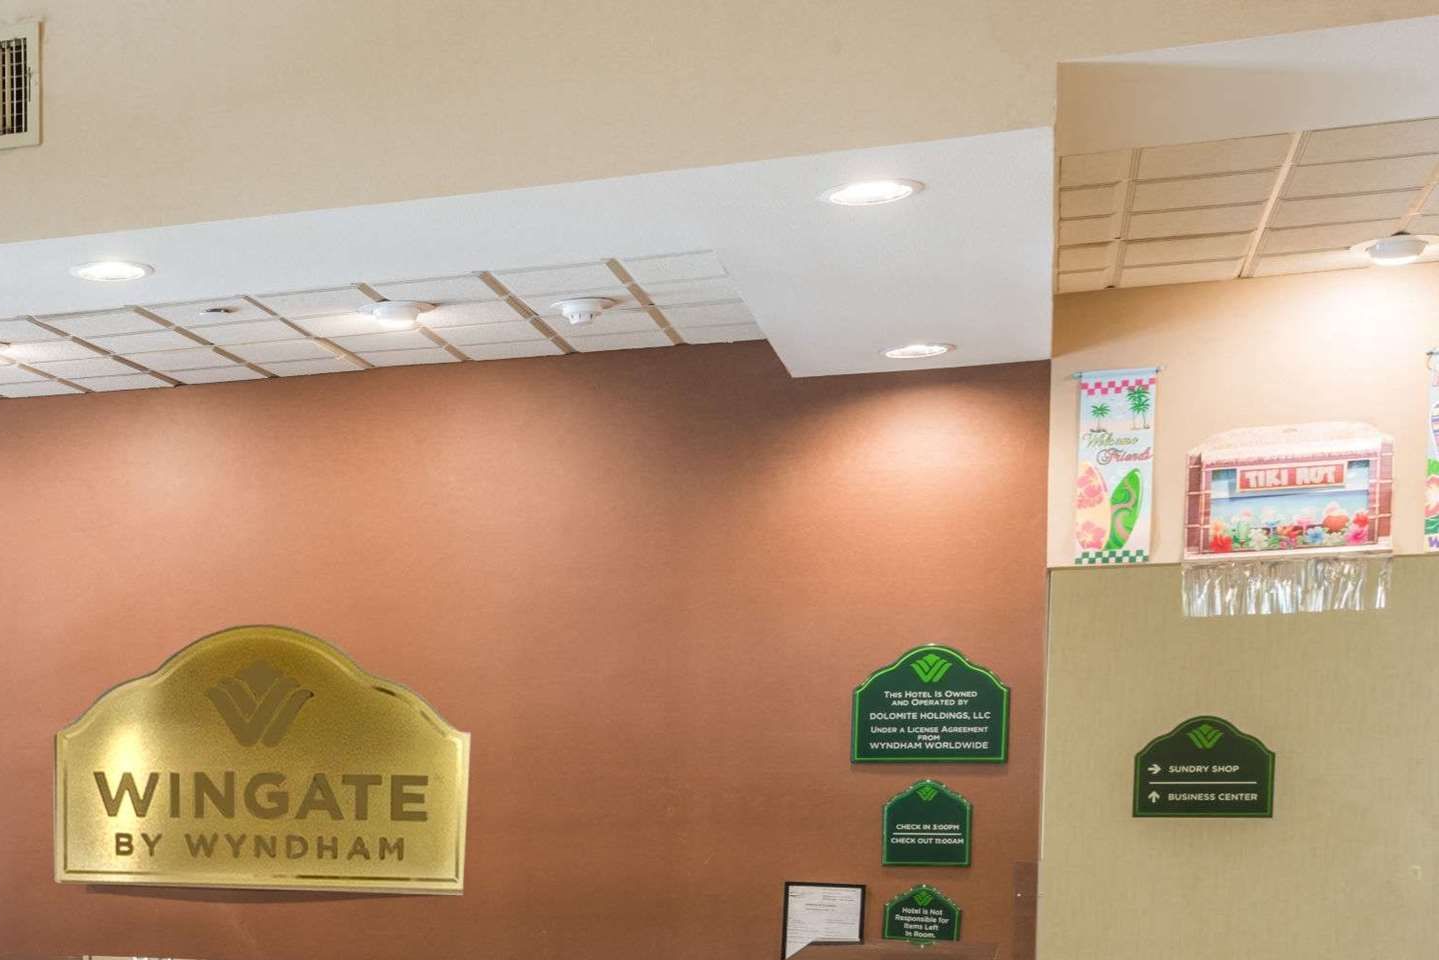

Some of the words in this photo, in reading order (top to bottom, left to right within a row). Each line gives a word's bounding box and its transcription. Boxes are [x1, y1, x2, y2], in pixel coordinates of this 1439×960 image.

[1244, 468, 1289, 488] TIKI
[1296, 465, 1336, 485] HUT
[869, 712, 918, 720] DOLOMITE
[920, 712, 971, 720] HOLDINGS,
[924, 741, 989, 749] WORLDWIDE
[1168, 765, 1209, 773] SUNDRY
[1211, 765, 1240, 773] SHOP
[94, 771, 429, 821] WINGATE
[1168, 793, 1216, 801] BUSINESS
[1217, 793, 1258, 801] CENTER
[115, 833, 162, 857] BY
[184, 833, 405, 861] WYNDHAM
[902, 907, 921, 915] Hotel
[930, 908, 943, 916] Not
[894, 914, 937, 924] Responsible
